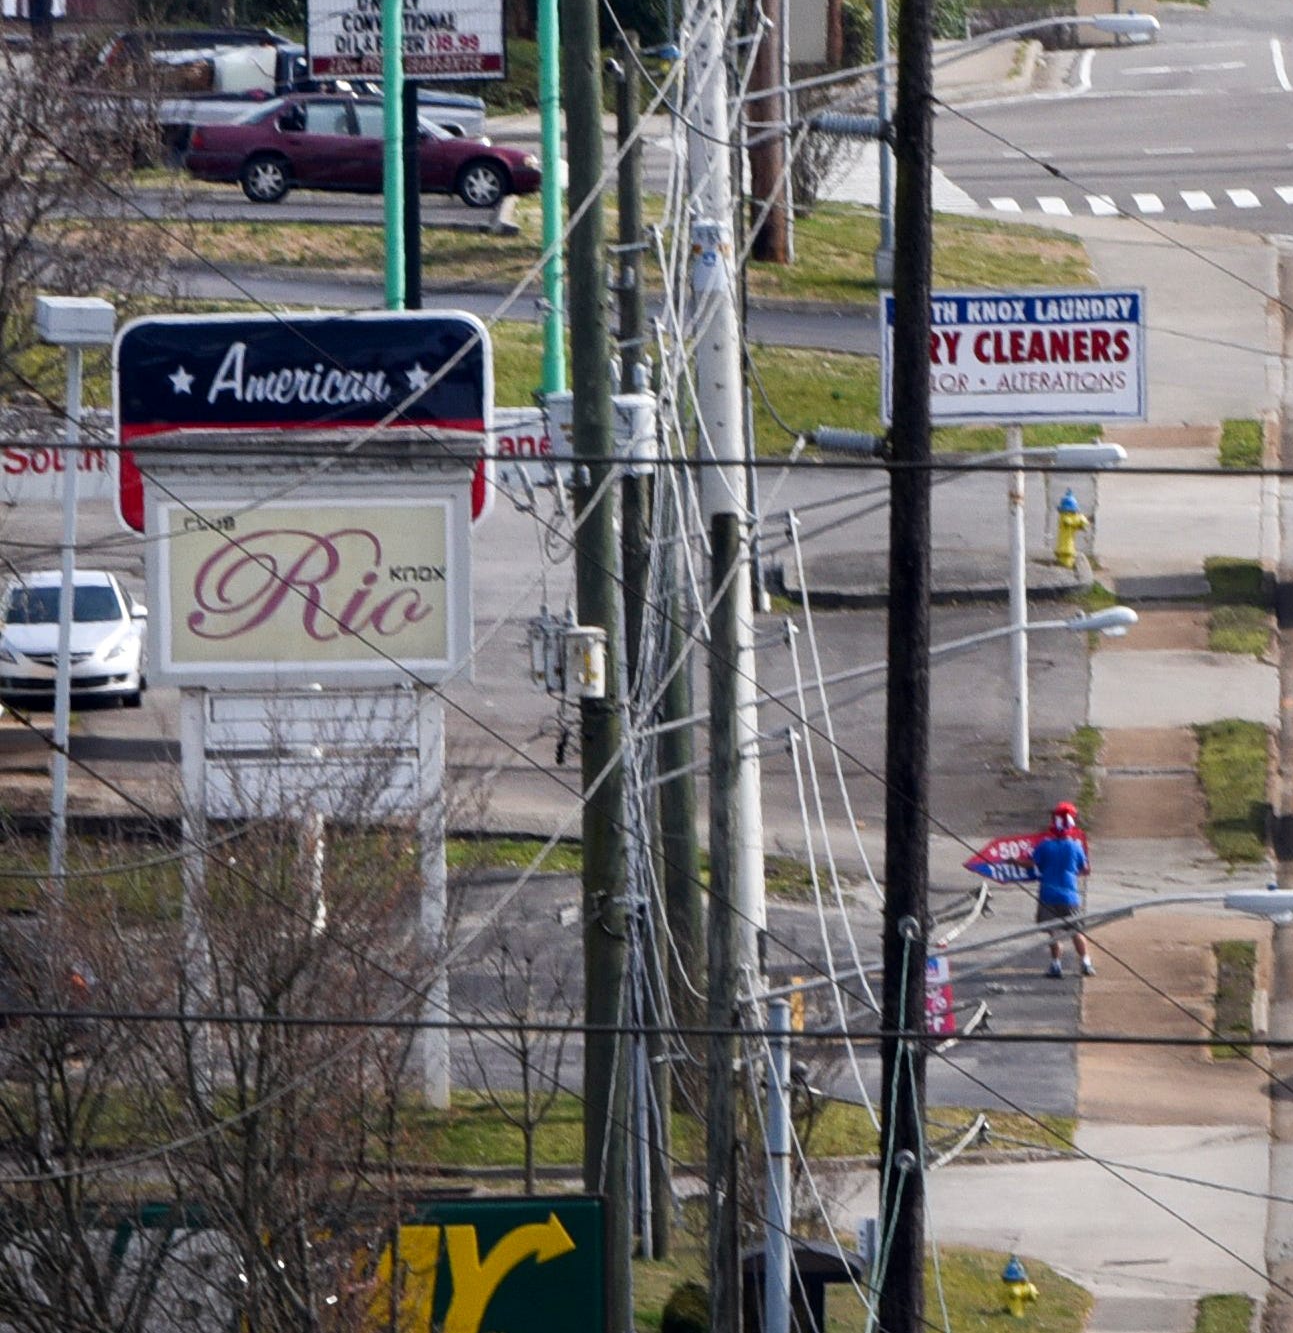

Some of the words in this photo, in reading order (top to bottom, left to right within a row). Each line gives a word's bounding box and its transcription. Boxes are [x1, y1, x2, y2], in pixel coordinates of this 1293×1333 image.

[966, 299, 1027, 323] KNOX
[1034, 296, 1132, 321] LAUNDRY
[973, 329, 1130, 364] CLEANERS
[207, 341, 391, 405] American
[996, 370, 1127, 393] ALTERATIONS
[187, 528, 434, 642] Rio
